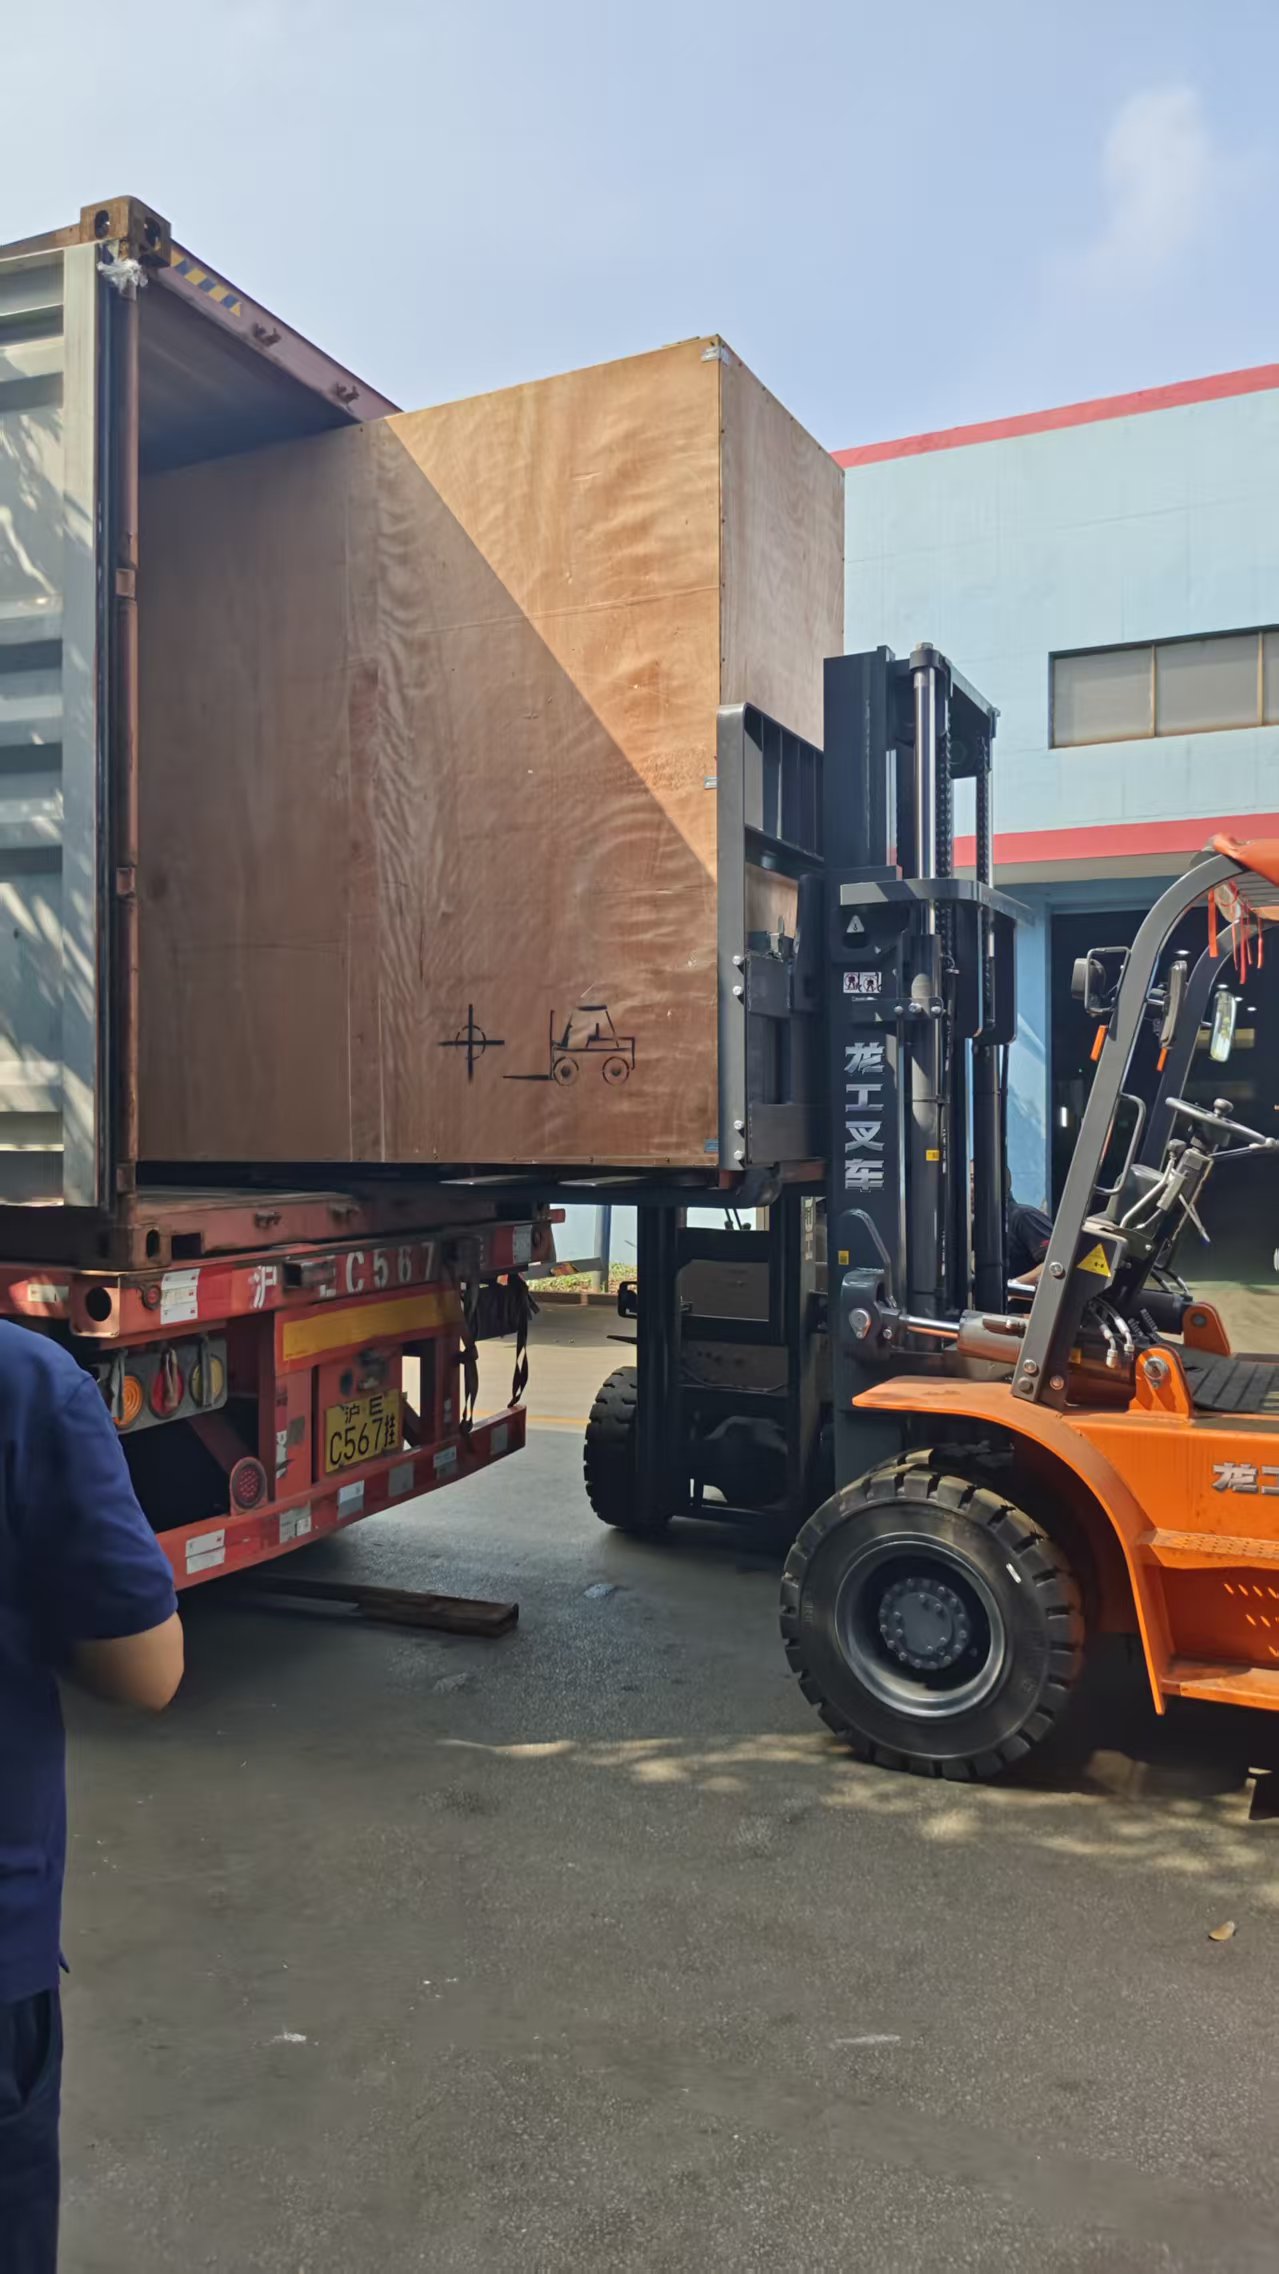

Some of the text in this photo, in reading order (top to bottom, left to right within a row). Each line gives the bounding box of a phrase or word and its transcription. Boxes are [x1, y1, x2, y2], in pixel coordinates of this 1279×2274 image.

[844, 1042, 885, 1192] 龙工叉车
[344, 1395, 384, 1424] 沪E
[329, 1413, 396, 1466] C567挂
